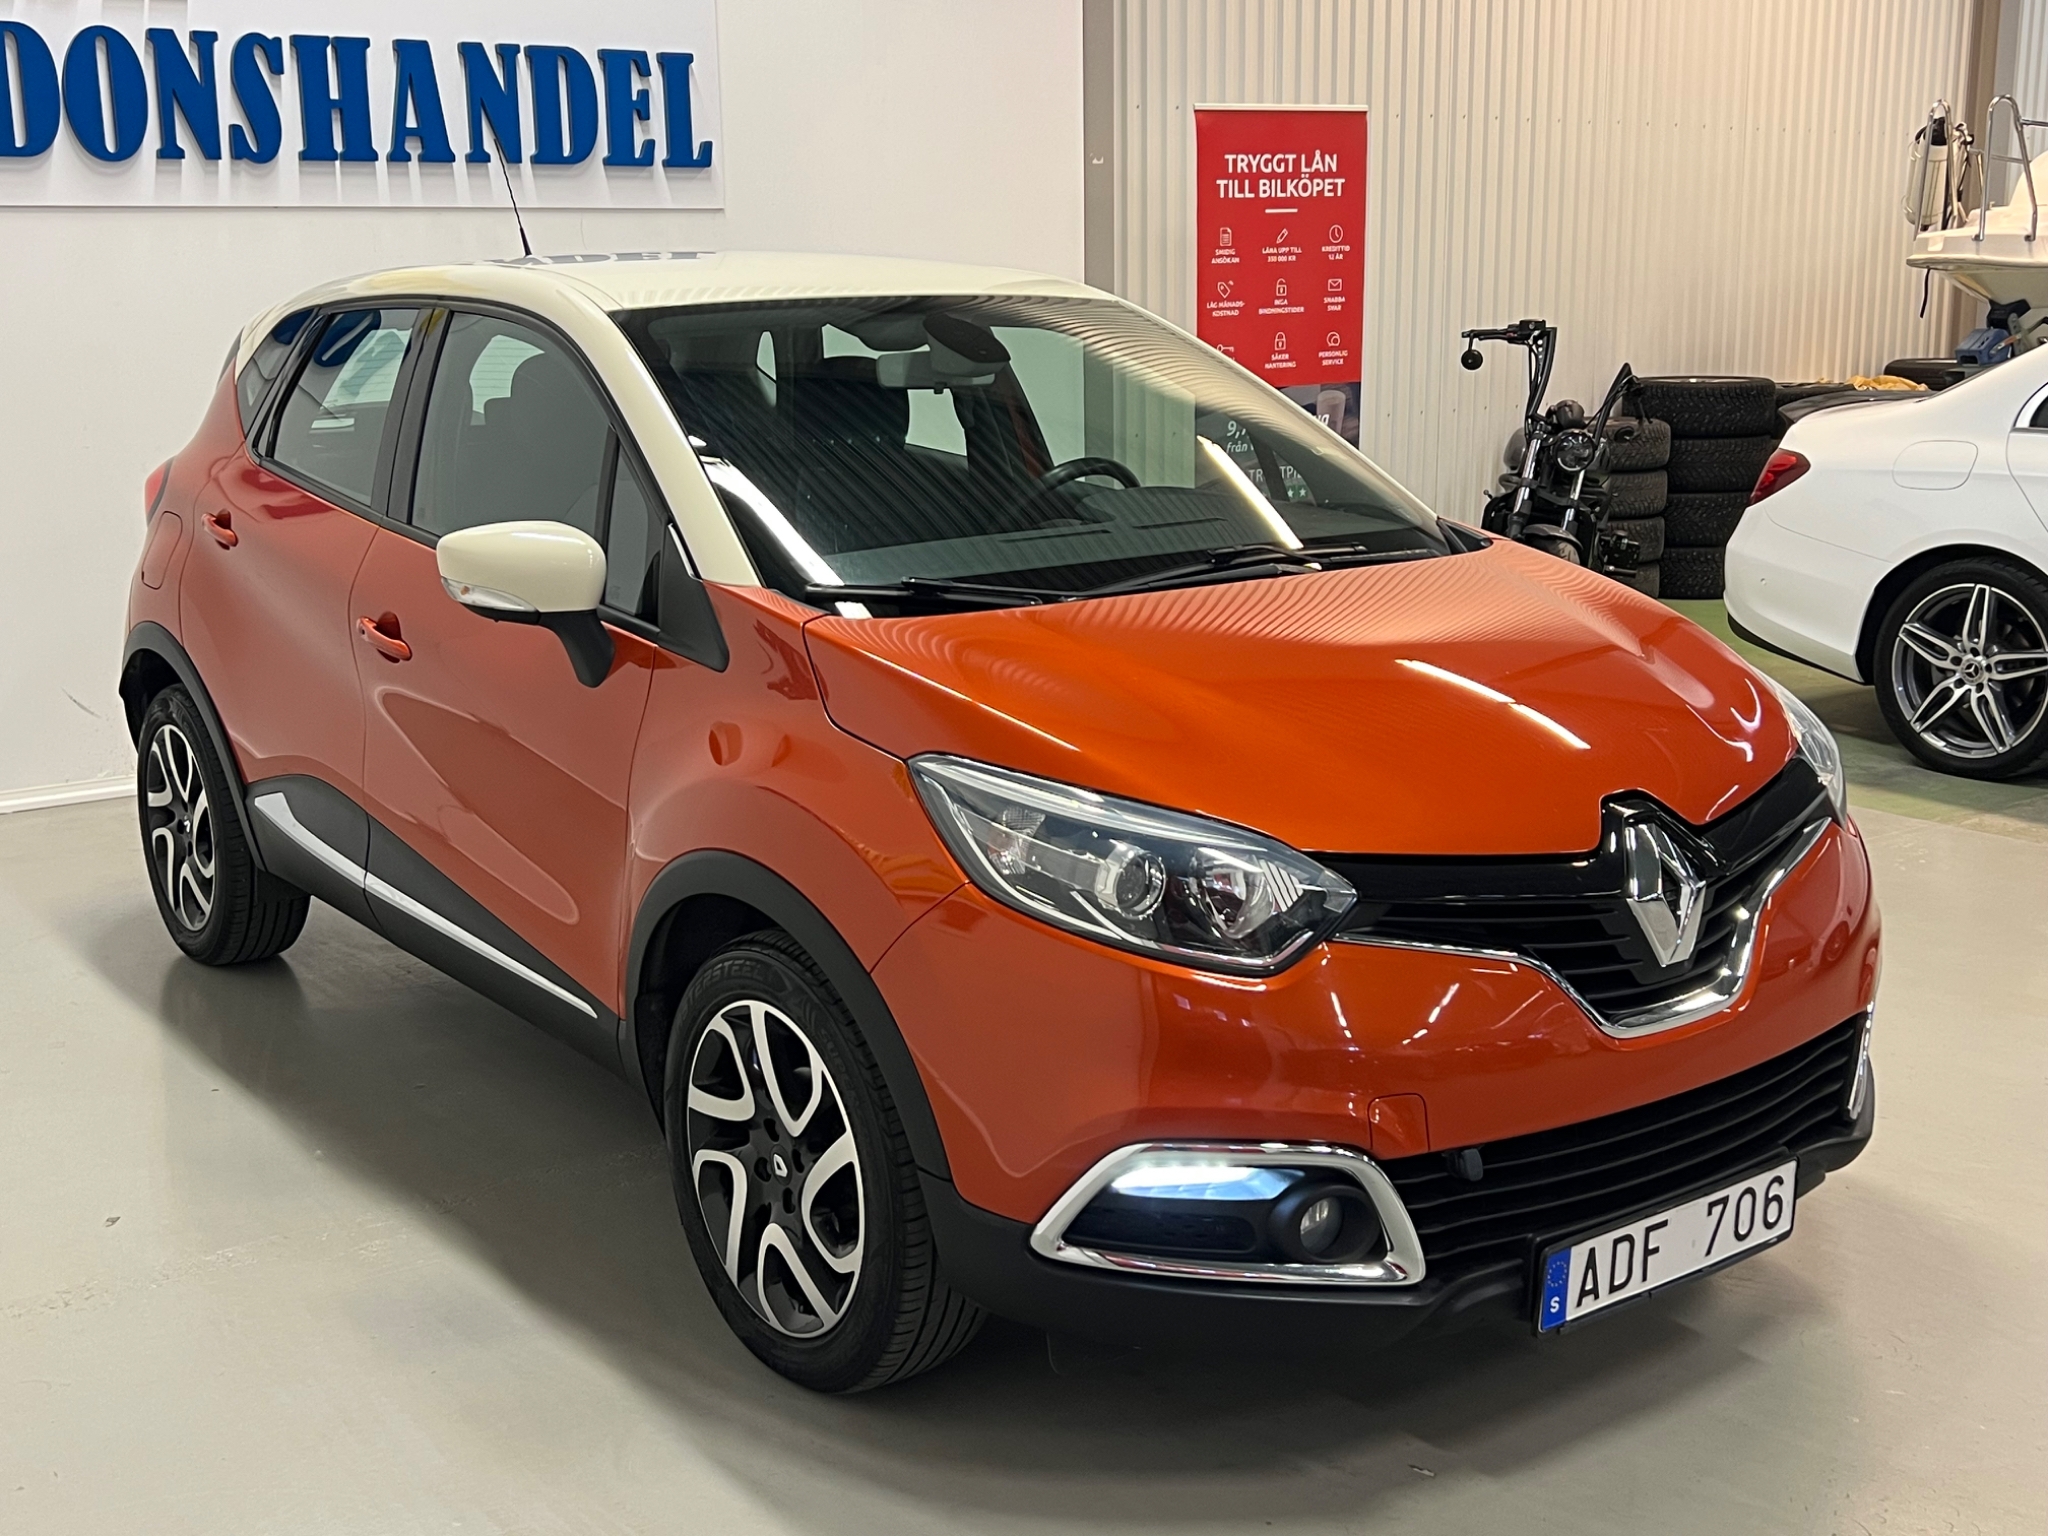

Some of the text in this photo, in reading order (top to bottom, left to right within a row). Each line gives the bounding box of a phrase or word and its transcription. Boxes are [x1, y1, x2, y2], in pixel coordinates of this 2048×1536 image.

[0, 20, 713, 169] DONSHANDEL
[1224, 149, 1338, 173] TRYGGT LÅN
[1216, 173, 1346, 199] TILL BILKÖPET
[1575, 1175, 1785, 1309] ADF 706
[1550, 1296, 1560, 1314] S
